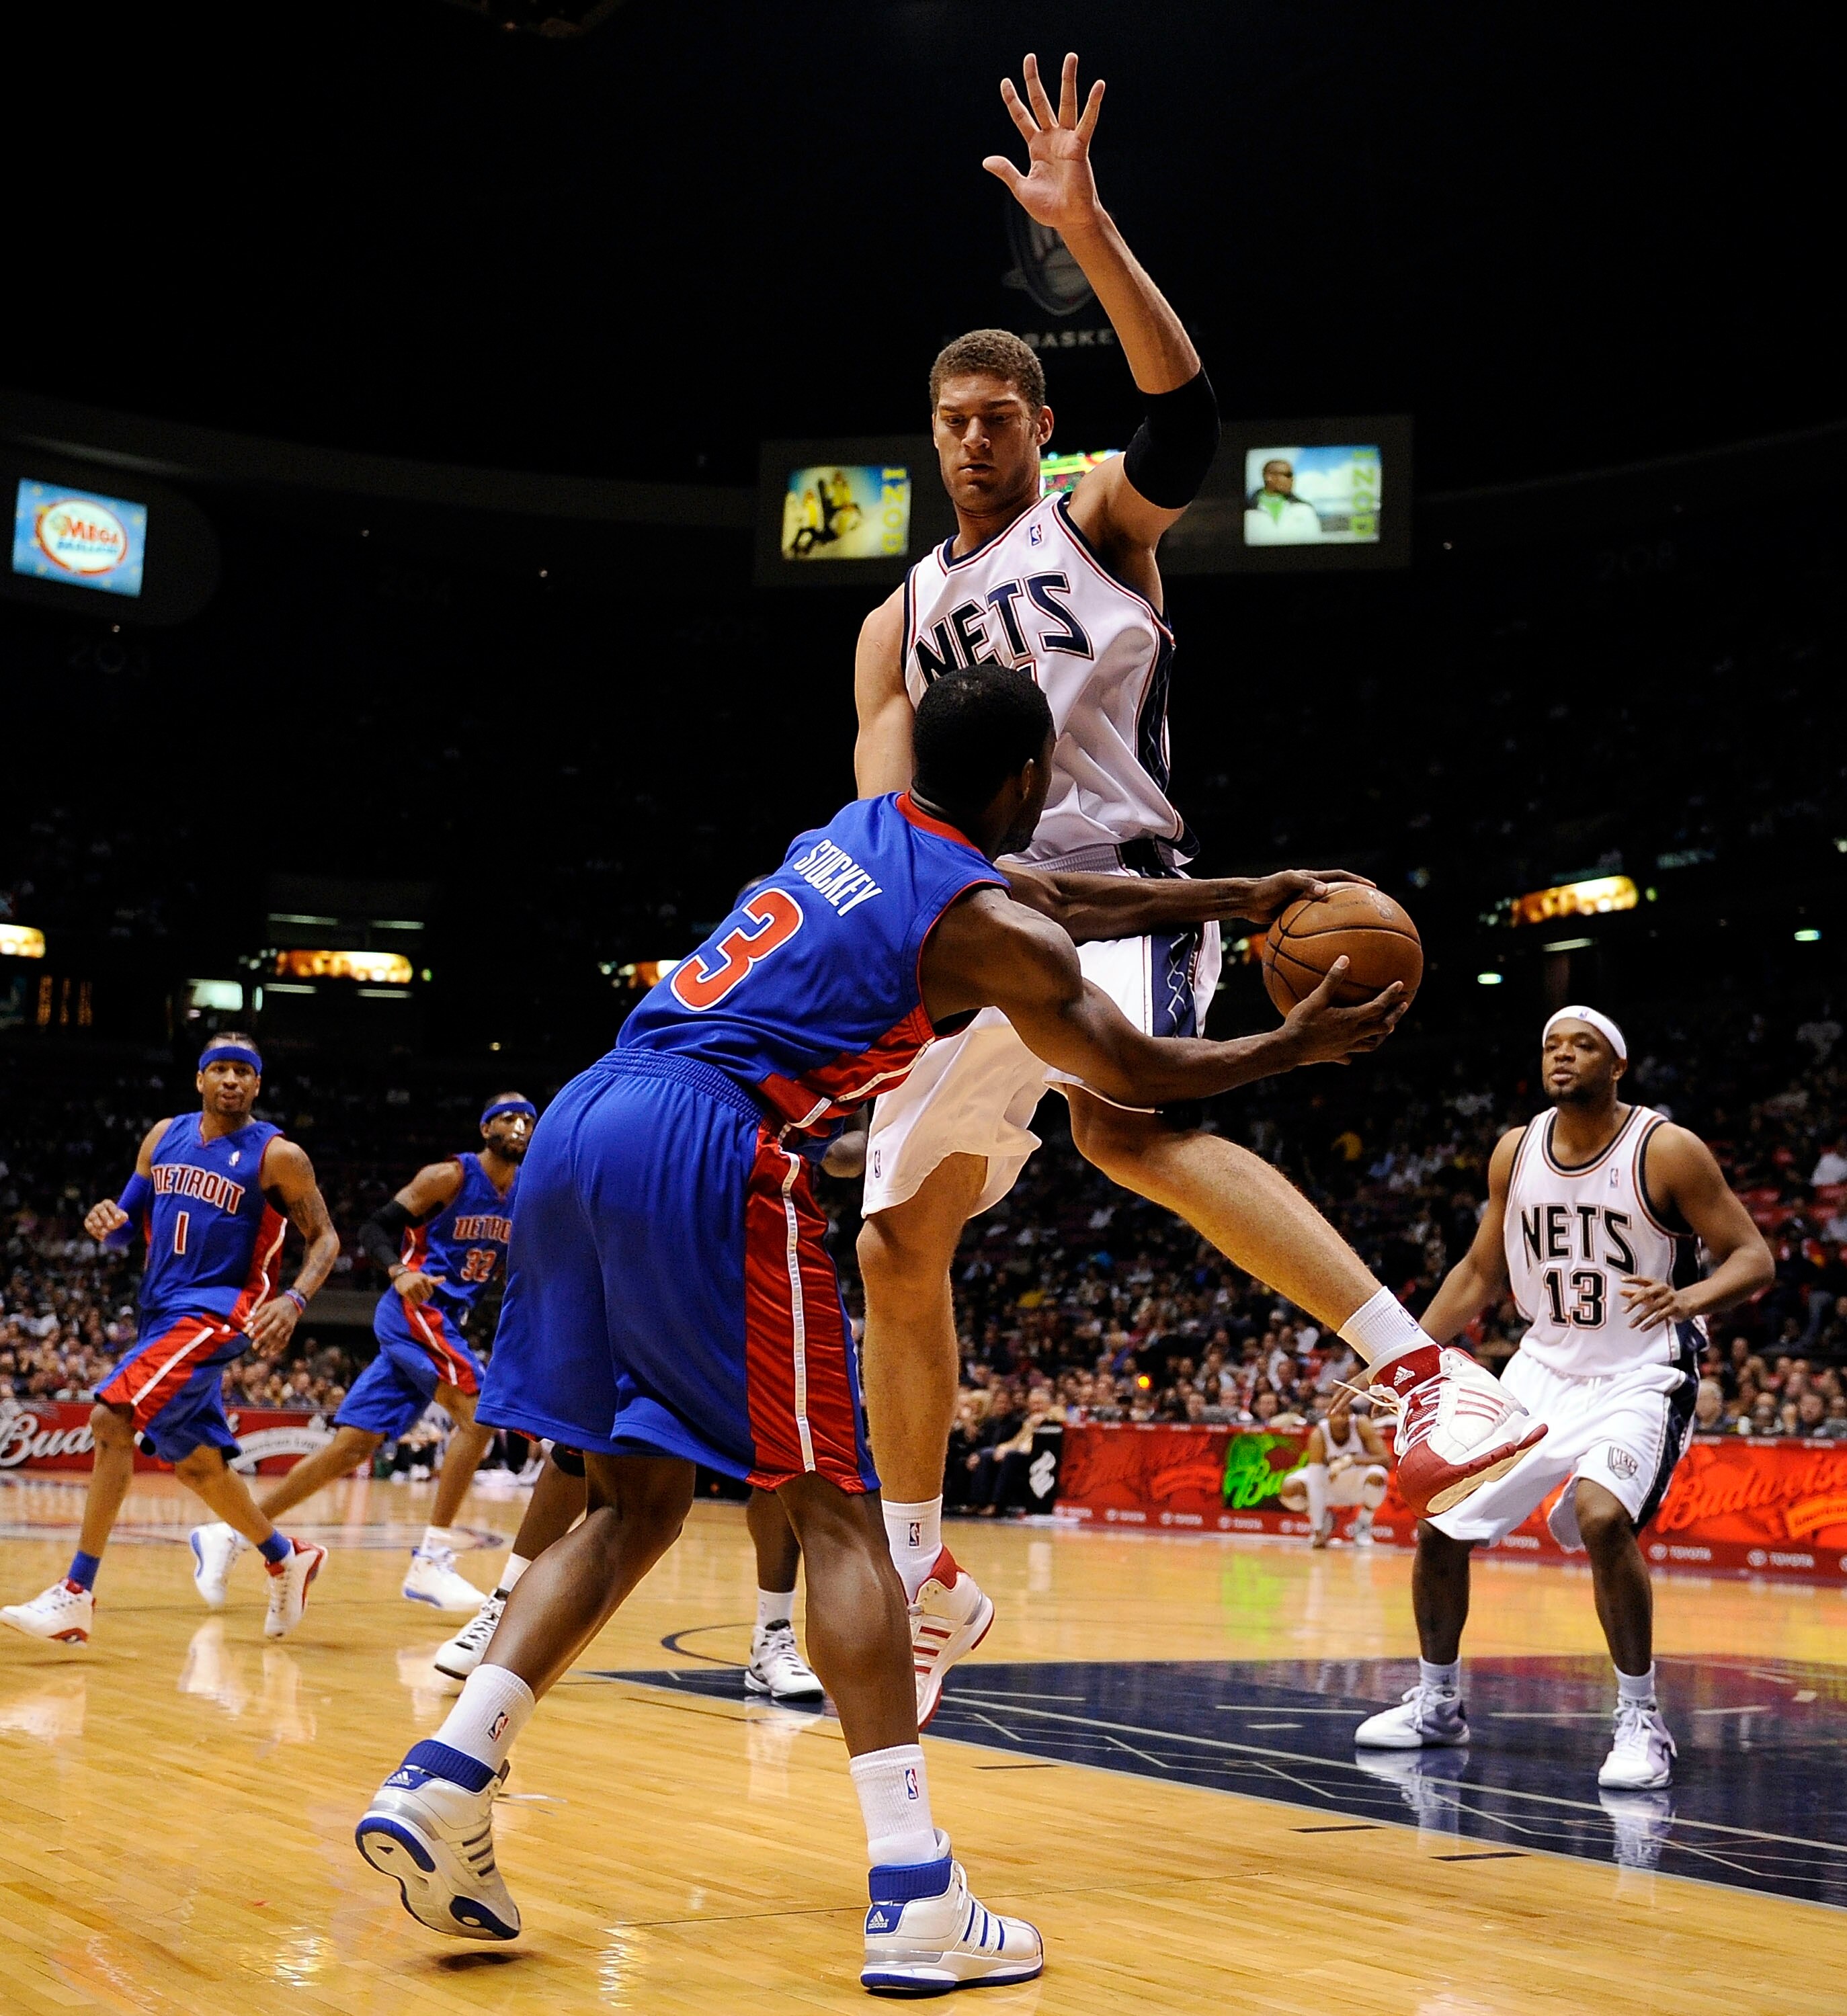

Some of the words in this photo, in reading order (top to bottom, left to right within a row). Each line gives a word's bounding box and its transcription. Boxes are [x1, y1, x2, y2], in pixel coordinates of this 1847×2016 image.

[1022, 327, 1116, 349] BASKE
[882, 468, 907, 553] IZOD
[1350, 451, 1377, 536] IZOD
[913, 571, 1094, 687] NETS
[793, 838, 883, 917] STUCKEY
[670, 887, 804, 1011] 3
[151, 1163, 245, 1215] DETROIT
[174, 1211, 190, 1254] 1
[453, 1215, 511, 1243] DETRO
[1520, 1204, 1638, 1275] NETS
[460, 1247, 496, 1282] 32
[1543, 1268, 1608, 1329] 13
[1669, 1546, 1712, 1561] TOYOTA
[1769, 1552, 1815, 1569] TOYOTA
